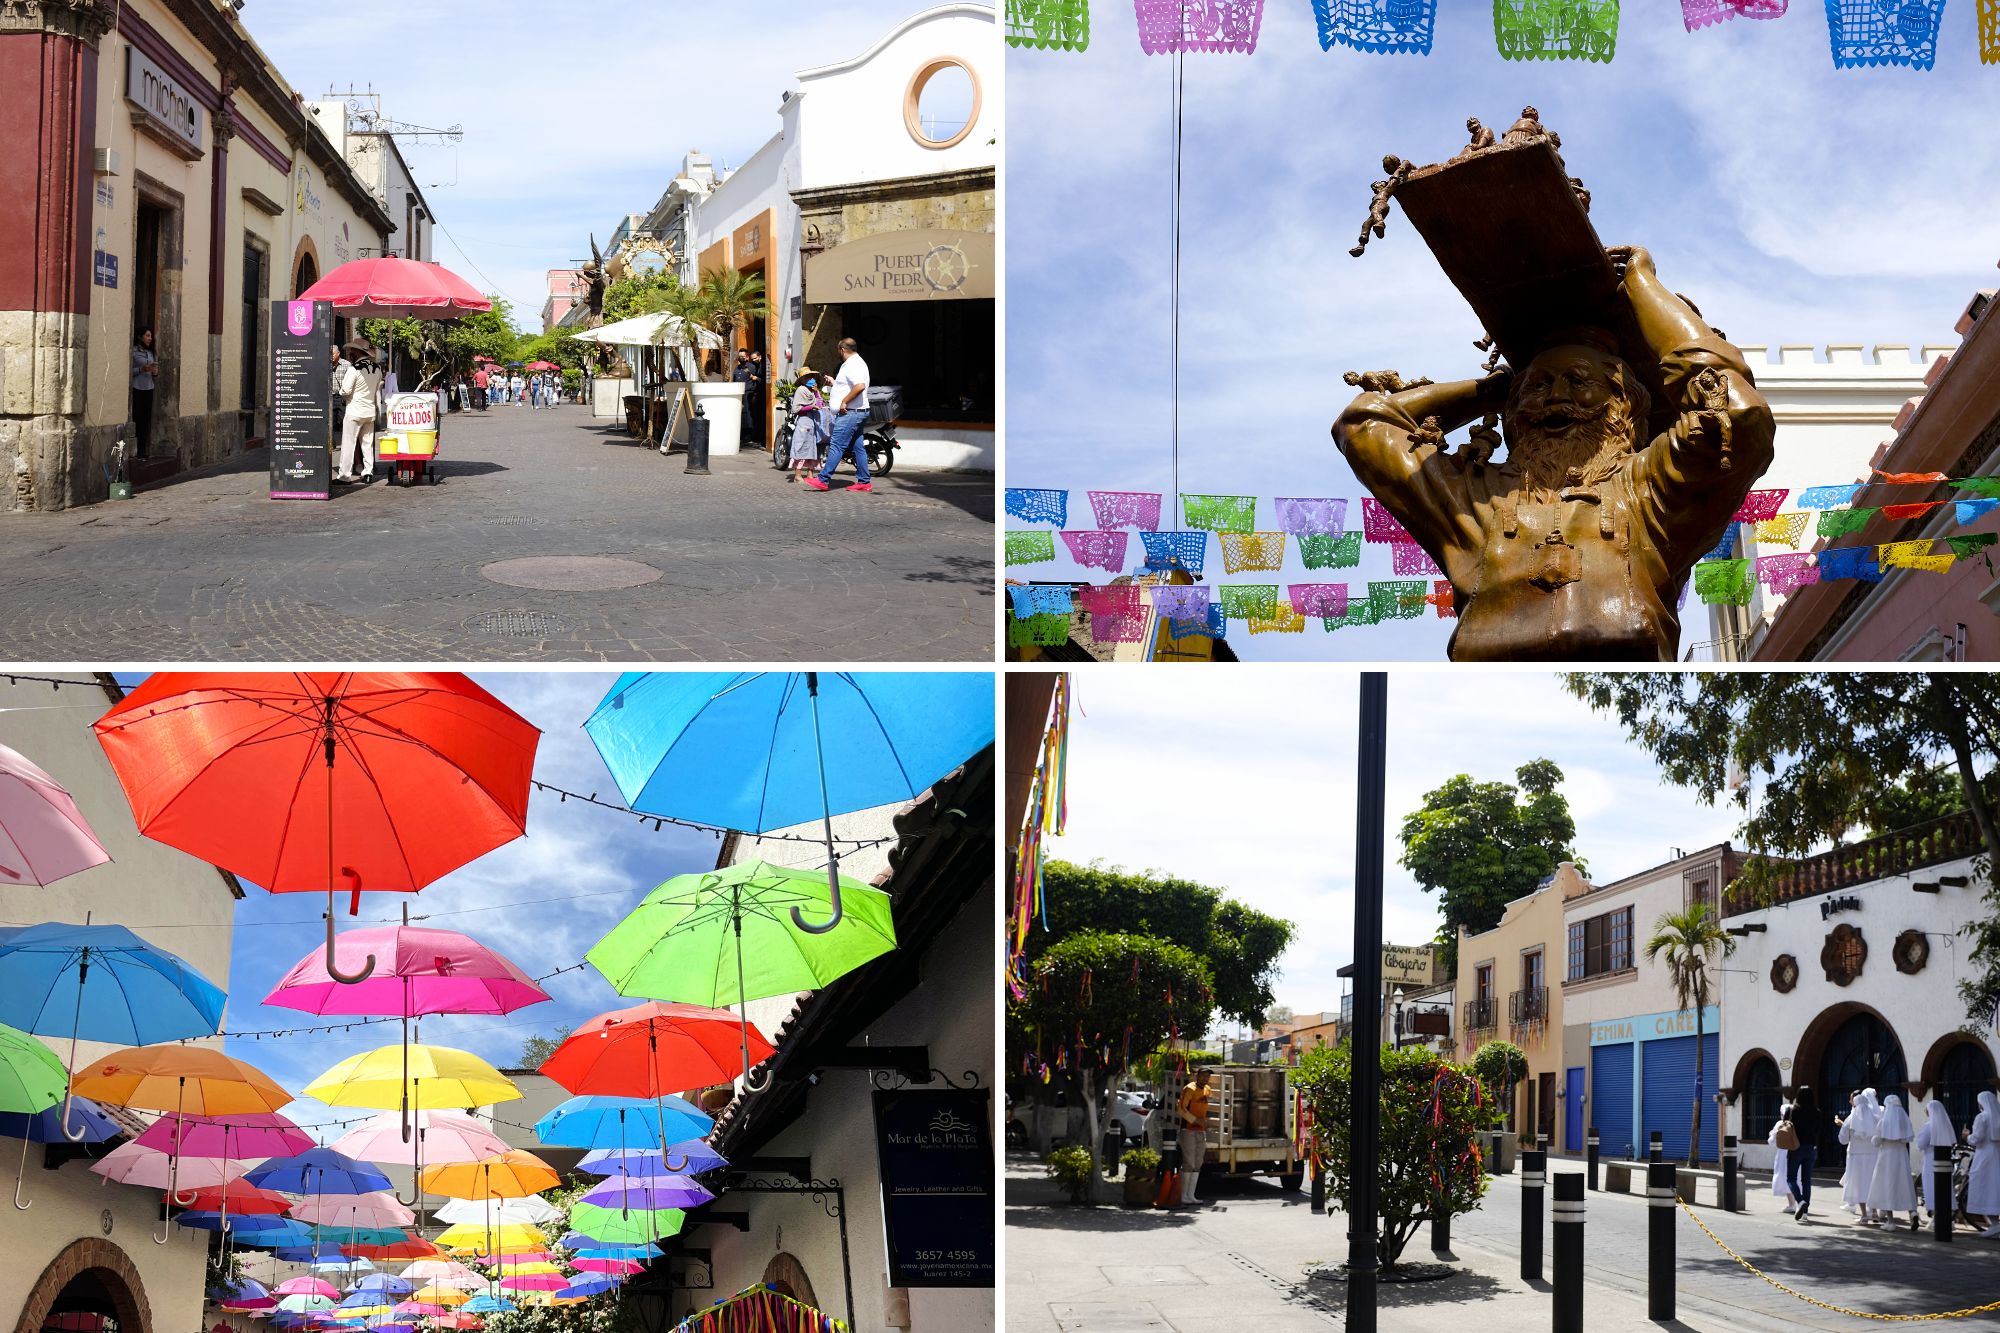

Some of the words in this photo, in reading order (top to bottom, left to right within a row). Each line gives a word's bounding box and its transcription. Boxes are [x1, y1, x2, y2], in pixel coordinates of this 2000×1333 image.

[143, 68, 195, 138] michelle
[844, 274, 875, 291] SAN
[391, 410, 432, 425] HELADOS
[1590, 1023, 1634, 1041] FEMINA
[1655, 1013, 1695, 1035] CARE
[887, 1133, 911, 1144] Mar
[914, 1132, 928, 1144] de
[931, 1132, 942, 1144] la
[894, 1185, 922, 1193] Jewelry,
[923, 1185, 949, 1193] Leather
[951, 1185, 965, 1193] and
[966, 1185, 983, 1193] Gifts
[915, 1250, 943, 1260] 3657
[947, 1250, 976, 1260] 4595
